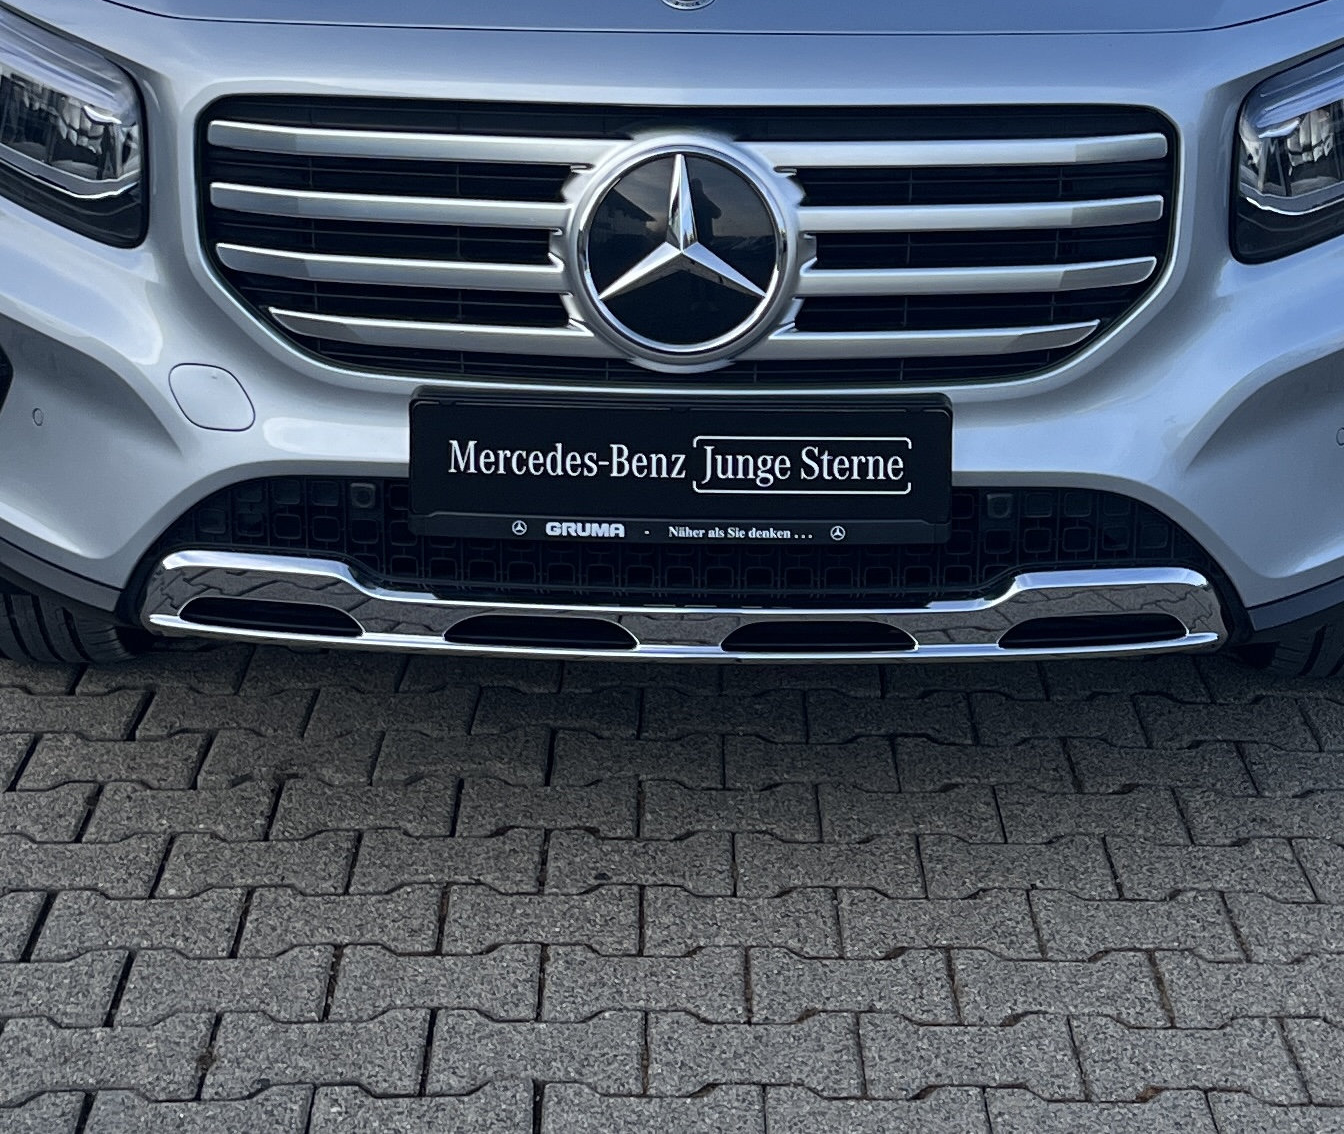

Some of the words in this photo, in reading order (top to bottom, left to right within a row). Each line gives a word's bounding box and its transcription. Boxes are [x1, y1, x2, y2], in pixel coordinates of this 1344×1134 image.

[448, 440, 686, 478] Mercedes-Benz
[701, 446, 791, 487] Junge
[800, 446, 904, 480] Sterne
[545, 521, 625, 537] GRUMA
[668, 526, 705, 538] Näher
[708, 527, 725, 538] als
[727, 527, 745, 538] Sie
[748, 527, 791, 539] denken
